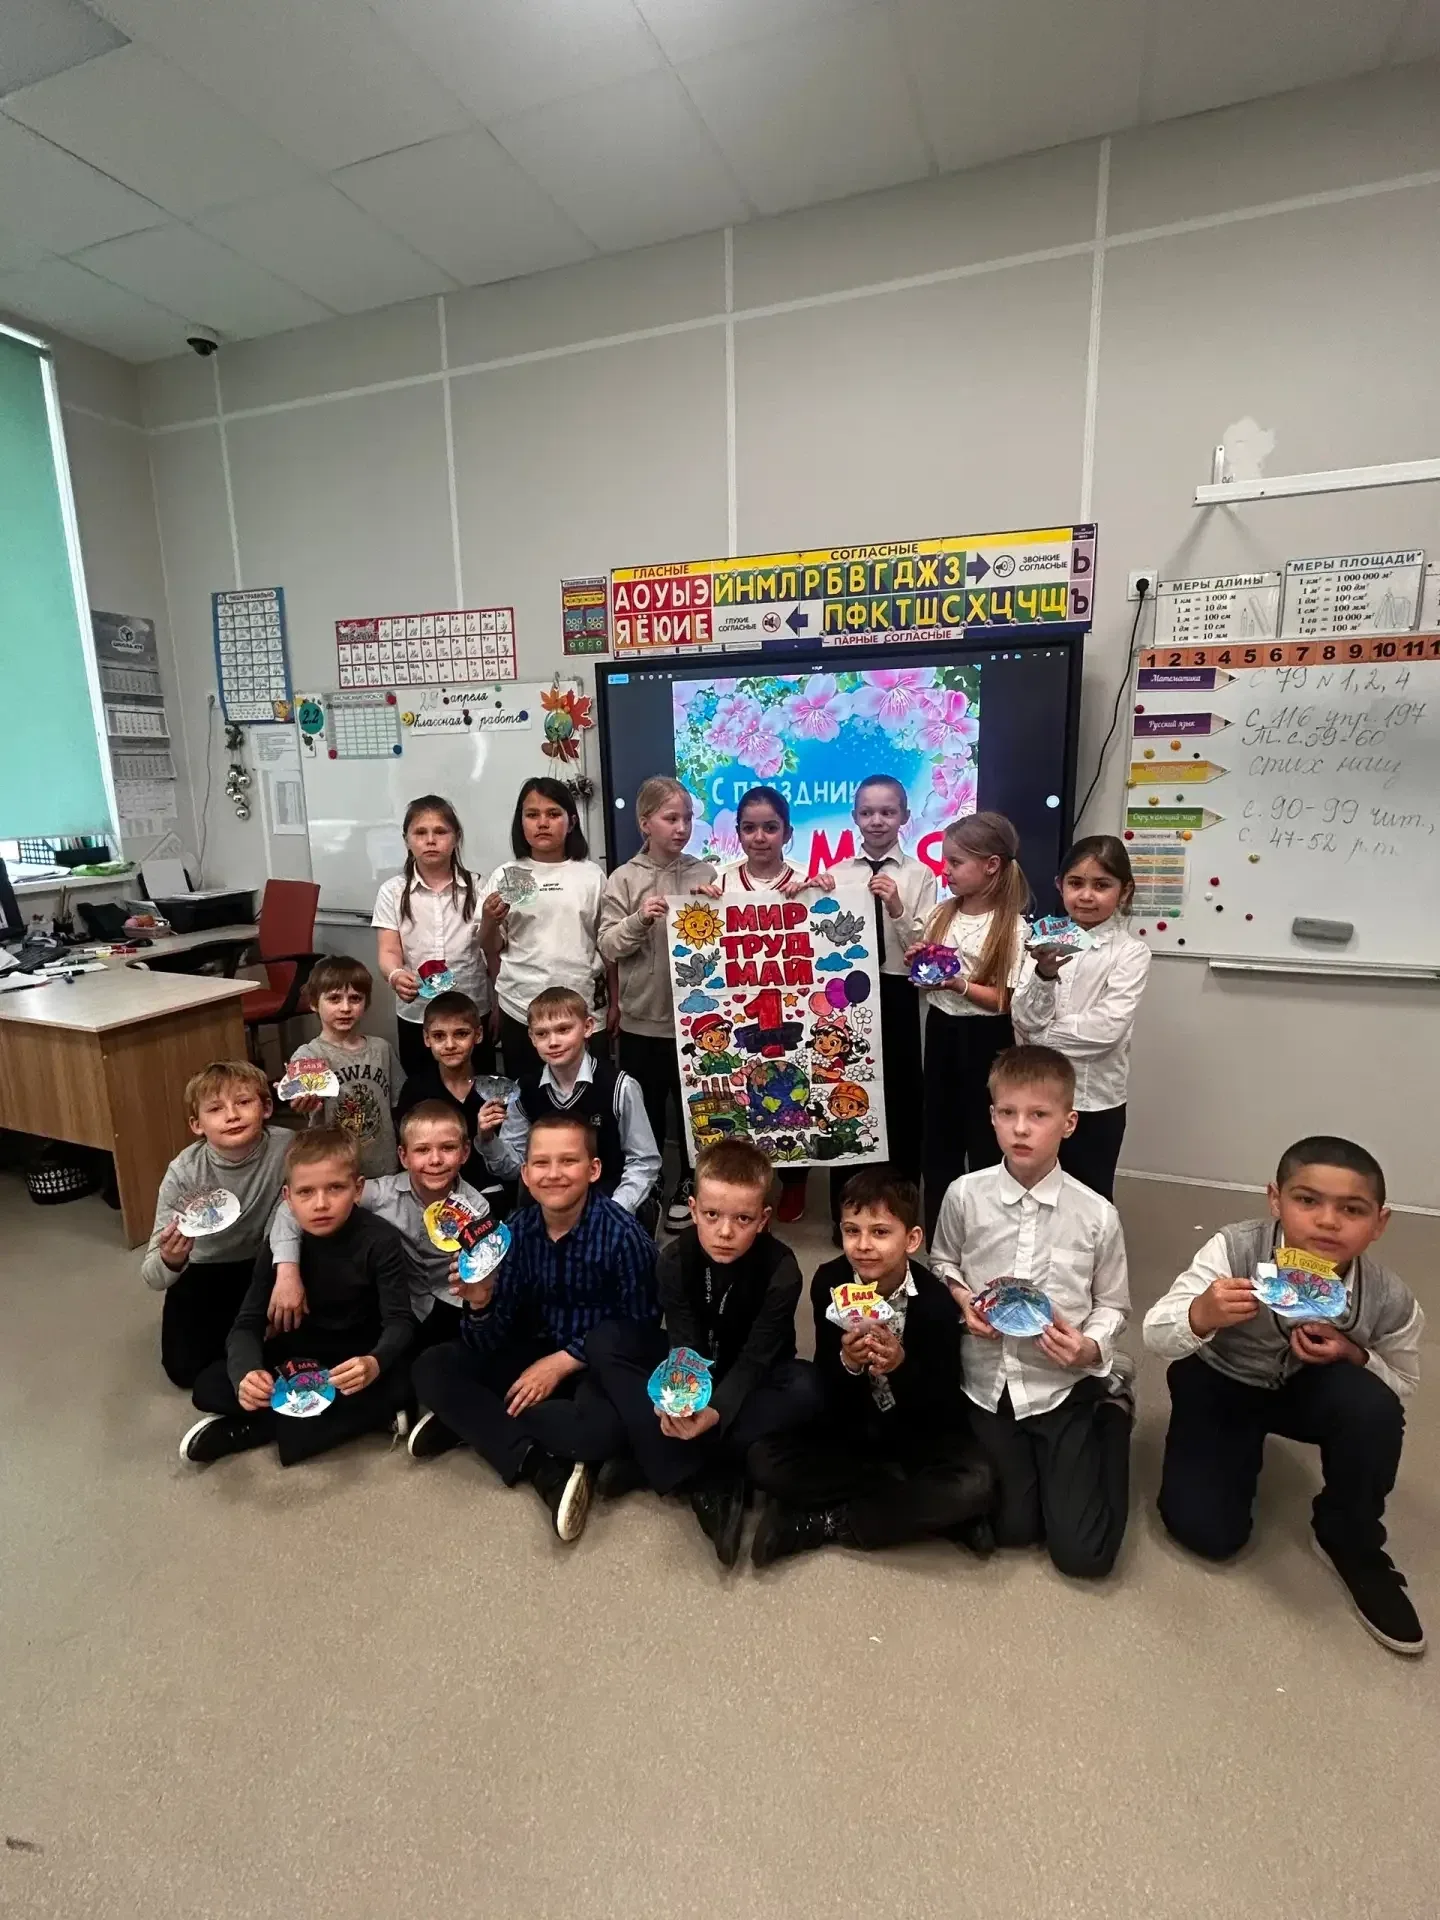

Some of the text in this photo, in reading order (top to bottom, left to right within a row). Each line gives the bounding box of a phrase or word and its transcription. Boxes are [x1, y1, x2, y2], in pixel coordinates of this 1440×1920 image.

[831, 543, 918, 561] СОГЛАСНЫЕ
[1022, 554, 1060, 563] ЗВОНКИЕ
[633, 564, 690, 579] ГЛАСНЫЕ
[1019, 561, 1068, 572] СОГЛАСНЫЕ
[1293, 553, 1415, 572] МЕРЫ ПЛОЩАДИ
[1172, 576, 1263, 592] МЕРЫ ДЛИНЫ
[718, 623, 757, 632] СОГЛАСНЫЕ
[834, 630, 952, 646] ПАРНЫЕ СОГЛАСНЫЕ
[1146, 654, 1156, 667] 1
[1169, 653, 1182, 667] 2
[1194, 652, 1206, 666] 3
[1218, 650, 1231, 664] 4
[1244, 649, 1257, 663] 5
[1269, 648, 1283, 662] 6
[1296, 647, 1310, 661] 7
[1322, 646, 1336, 660] 8
[1373, 642, 1396, 657] 10
[1403, 641, 1424, 656] 11
[1151, 673, 1201, 682] Математика
[1276, 667, 1307, 693] 79
[1395, 667, 1411, 690] 4
[302, 708, 320, 724] 2.2
[1272, 706, 1315, 729] 116
[1149, 720, 1177, 731] Русский
[712, 776, 724, 805] С
[726, 902, 808, 933] МИР
[720, 932, 814, 960] ТРУД
[725, 957, 814, 988] МАЙ
[464, 1227, 476, 1248] 1
[1283, 1249, 1298, 1267] 1
[840, 1285, 874, 1308] 1 МАЯ
[286, 1360, 298, 1376] 1
